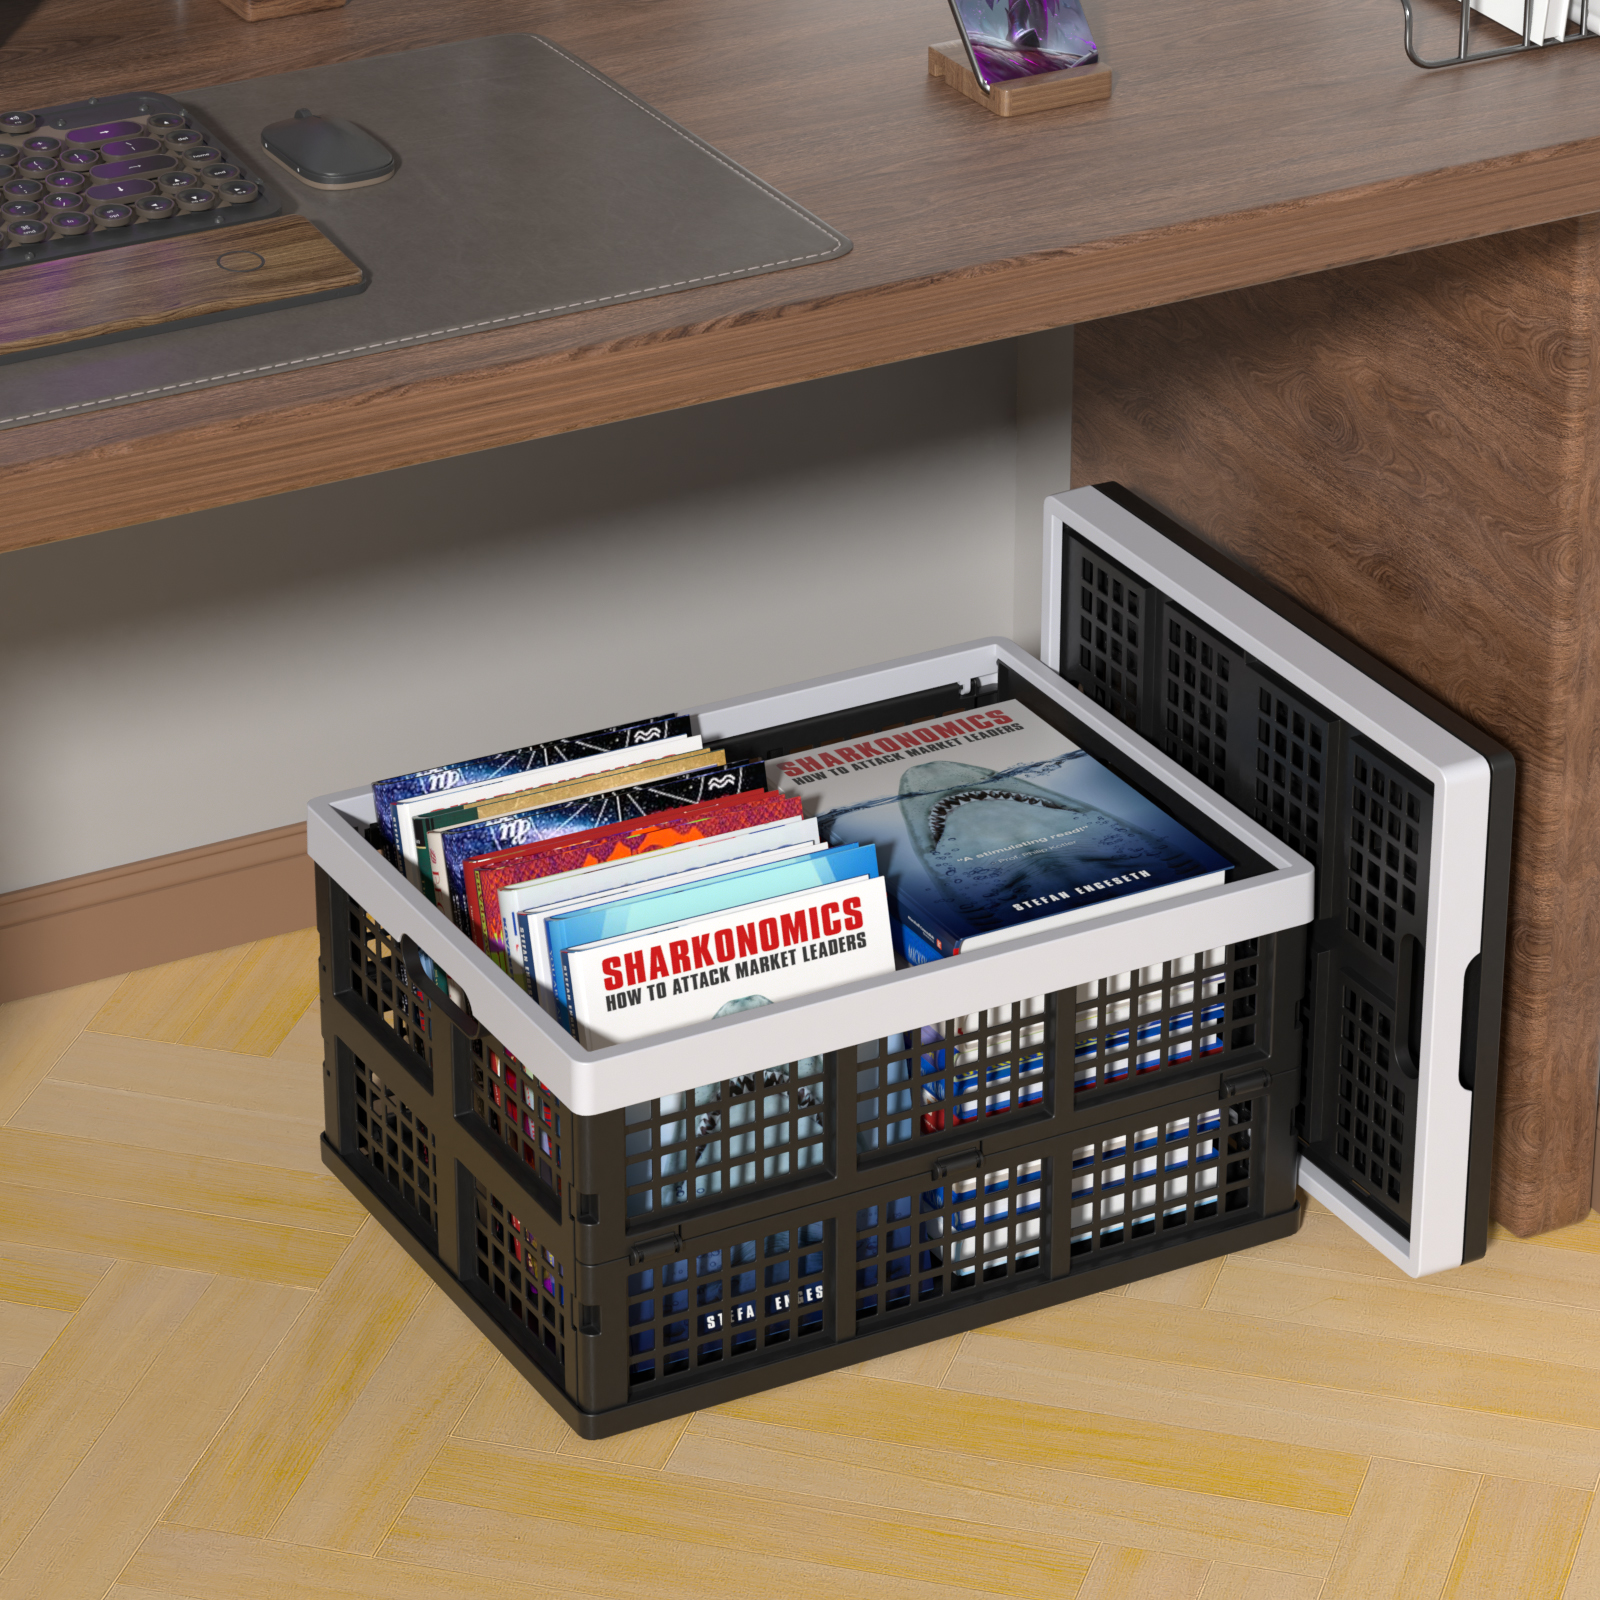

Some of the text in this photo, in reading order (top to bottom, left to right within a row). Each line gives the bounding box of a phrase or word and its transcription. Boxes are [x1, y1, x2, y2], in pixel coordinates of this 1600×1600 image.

[777, 709, 1014, 777] SHARKONOMICS
[792, 722, 1025, 786] HOW TO ATTACK MARKET LEADERS
[975, 835, 1048, 859] stimulating
[1022, 847, 1048, 858] Philip
[1049, 840, 1077, 852] Kotler
[1012, 869, 1152, 912] STEFAN ENGESETH
[519, 926, 529, 962] STEFAN
[602, 896, 864, 991] SHARKONOMICS
[563, 964, 572, 1001] STEFAN
[605, 931, 868, 1012] HOW TO ATTACK MARKET LEADERS
